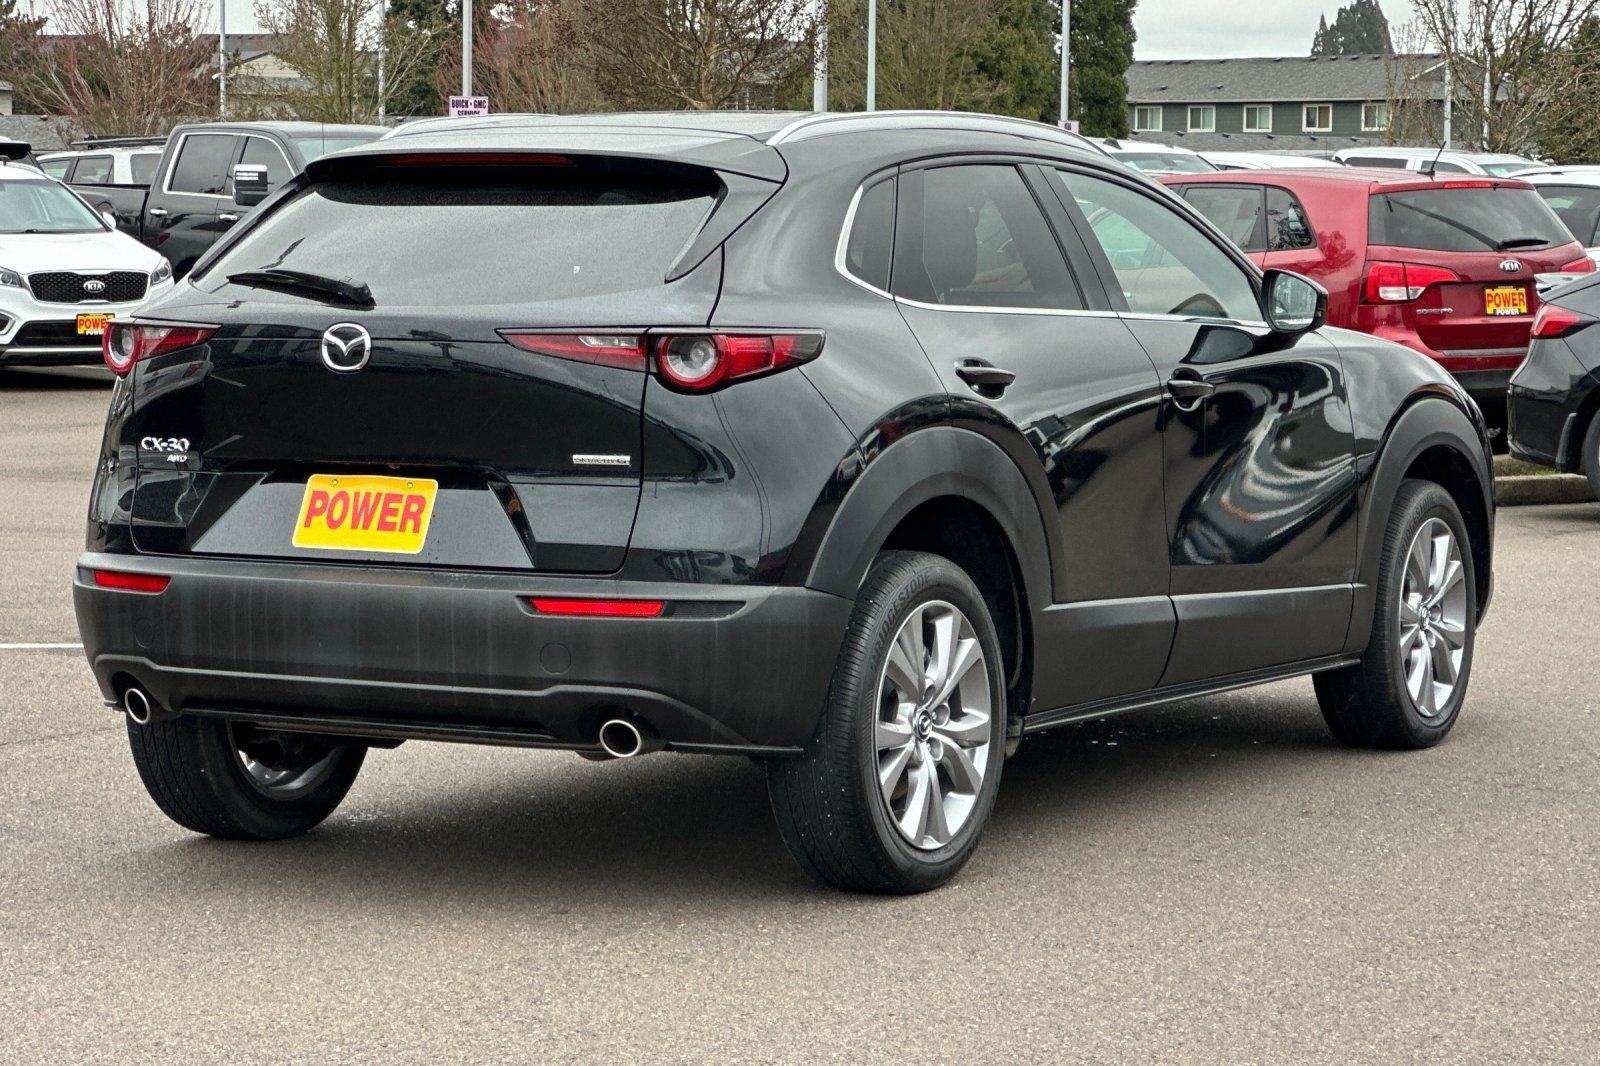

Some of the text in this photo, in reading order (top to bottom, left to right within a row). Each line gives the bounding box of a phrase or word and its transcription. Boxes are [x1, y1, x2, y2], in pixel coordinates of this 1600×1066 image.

[451, 99, 487, 109] BUICK GMC
[1486, 292, 1526, 307] POWER
[1496, 308, 1520, 316] POWER
[78, 318, 107, 330] POWE
[141, 436, 190, 452] CX-30
[166, 454, 188, 463] AWD
[303, 490, 427, 534] POWER
